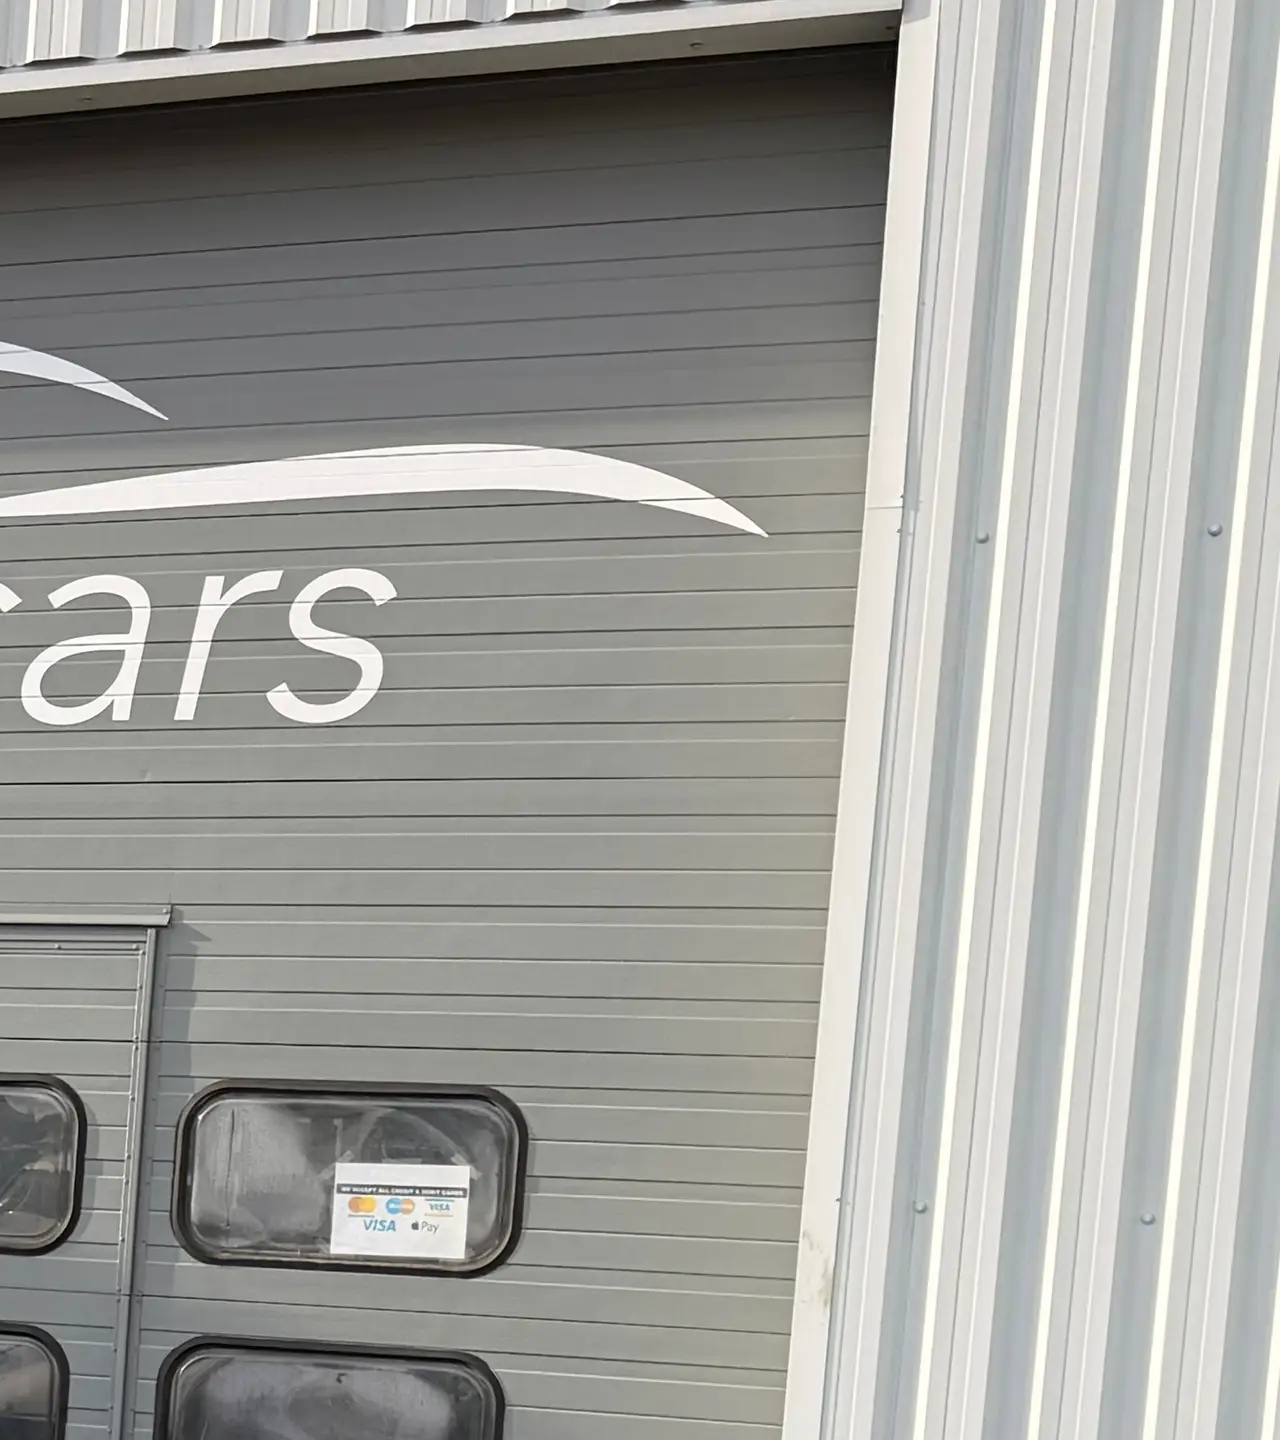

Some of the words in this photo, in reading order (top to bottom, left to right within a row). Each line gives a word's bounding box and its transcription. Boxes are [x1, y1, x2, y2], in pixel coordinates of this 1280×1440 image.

[429, 1203, 450, 1211] VISA
[363, 1219, 396, 1232] VISA
[421, 1221, 439, 1234] Pay
